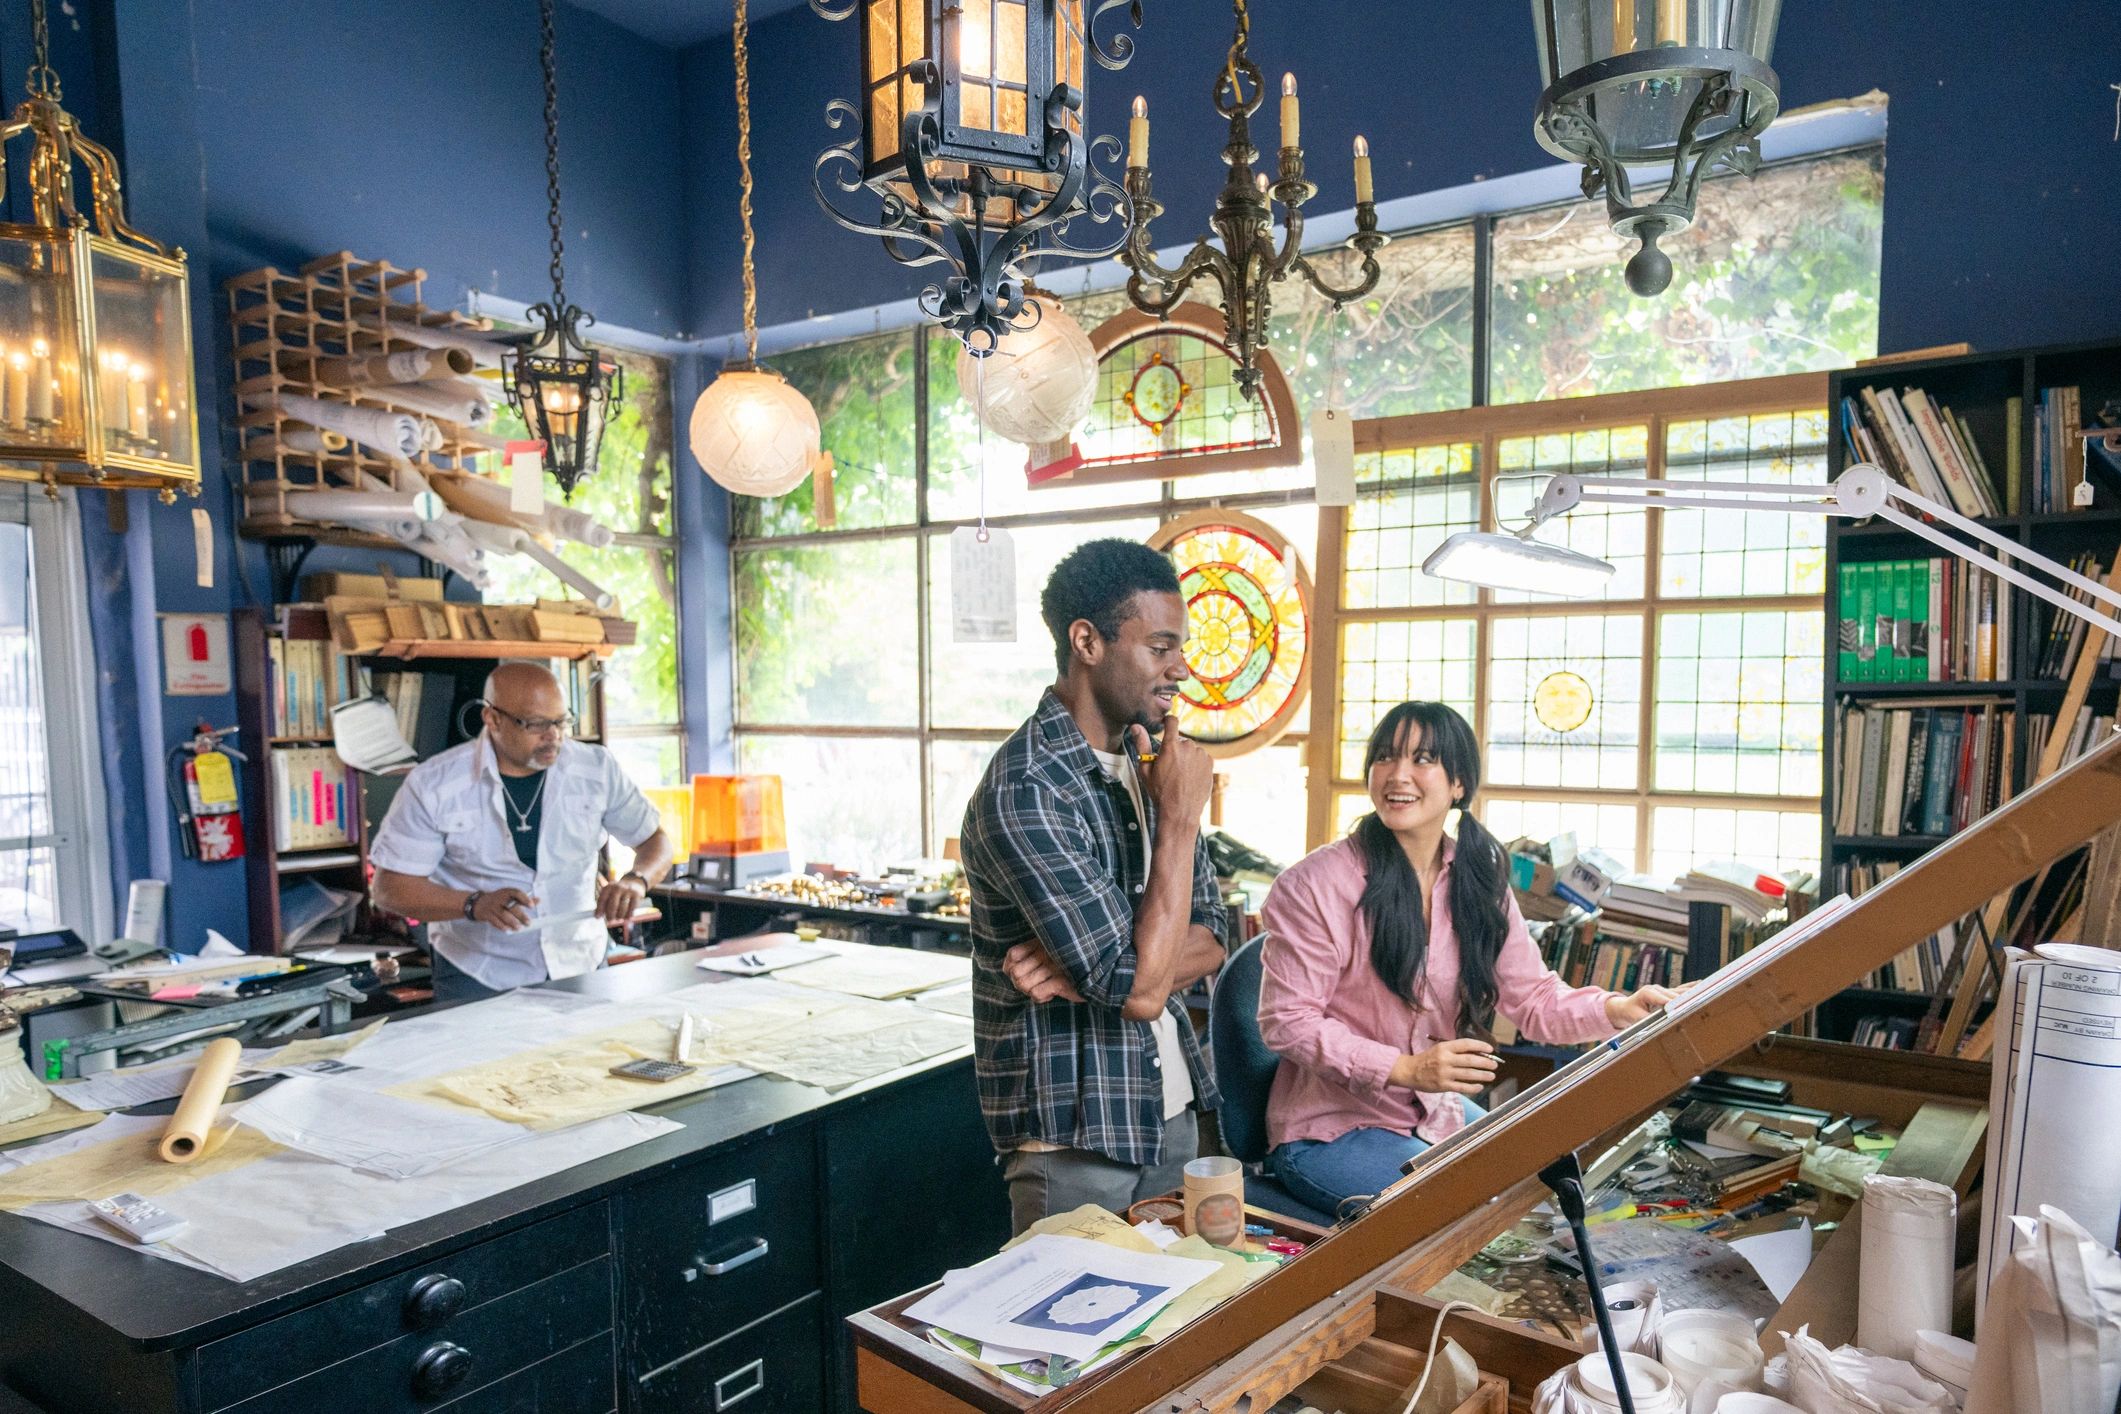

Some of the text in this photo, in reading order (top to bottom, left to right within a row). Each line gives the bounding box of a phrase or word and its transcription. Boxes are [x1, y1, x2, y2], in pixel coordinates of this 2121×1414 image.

[1907, 738, 1920, 795] AMERICA
[2062, 972, 2098, 984] 2 OF 10
[2051, 981, 2082, 990] NUMBER
